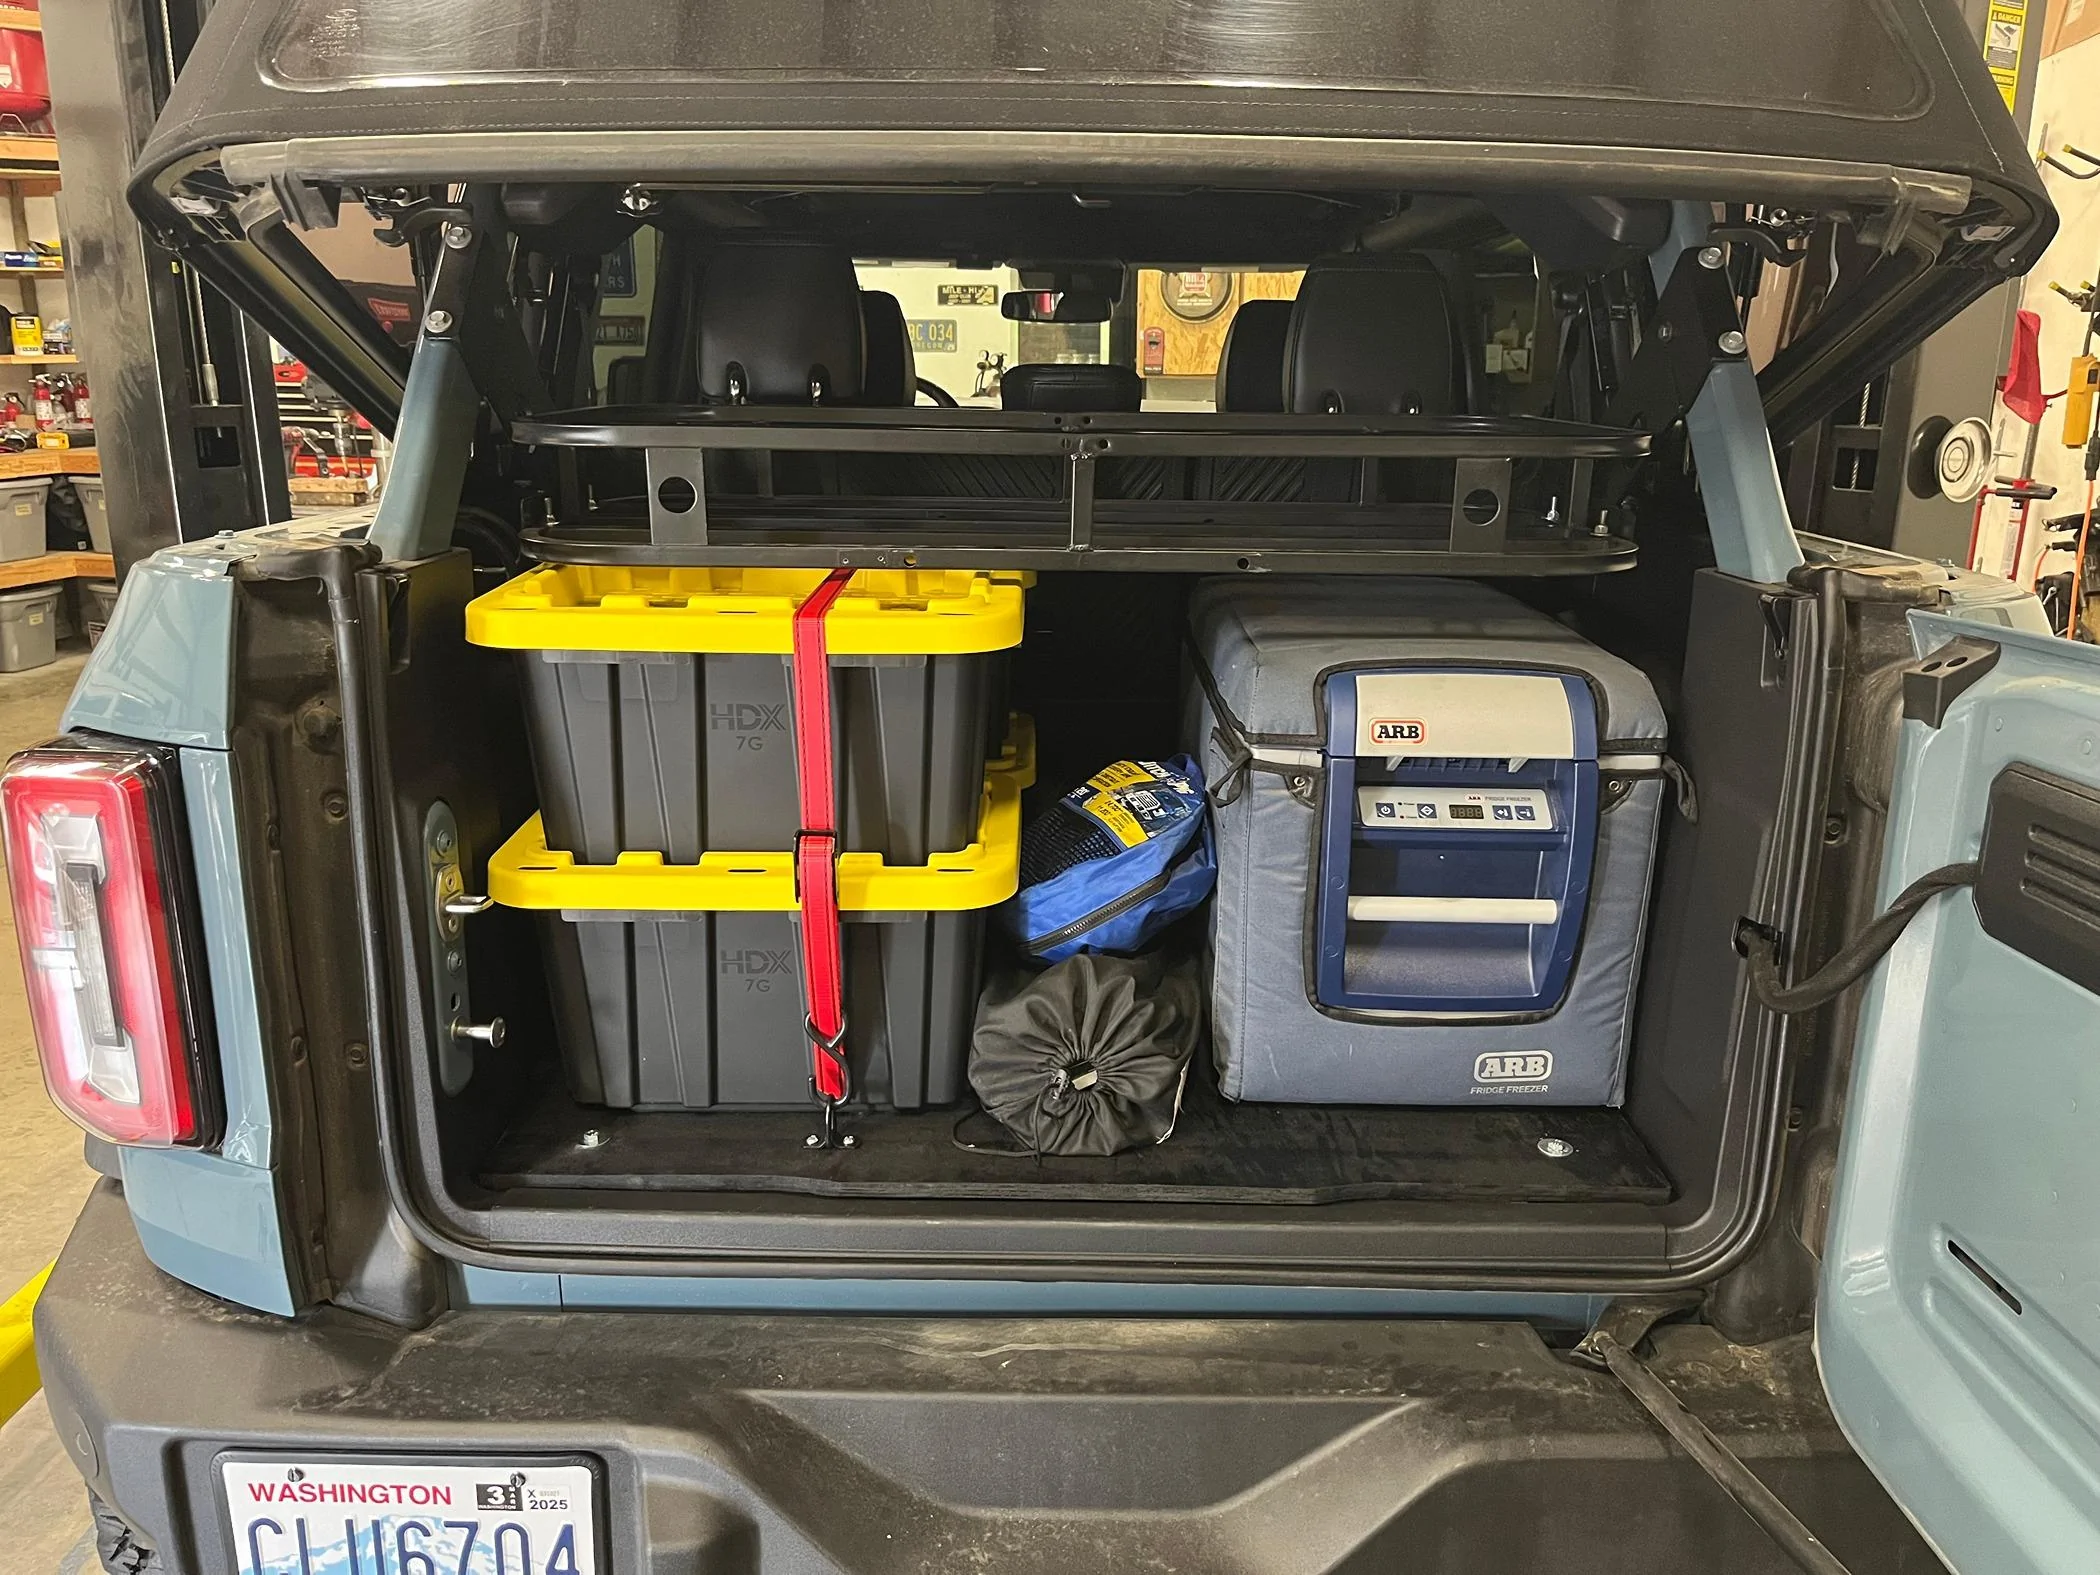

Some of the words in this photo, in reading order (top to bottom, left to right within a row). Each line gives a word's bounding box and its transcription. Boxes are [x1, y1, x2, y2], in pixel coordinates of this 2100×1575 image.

[929, 324, 953, 342] 034
[710, 703, 786, 731] HDX
[1377, 724, 1420, 739] ARB
[736, 735, 763, 751] 7G
[721, 949, 792, 975] HDX
[745, 978, 770, 993] 7G
[1481, 1056, 1545, 1078] ARB
[1470, 1086, 1505, 1095] FRIDGE
[1506, 1084, 1549, 1094] FREEZER
[248, 1482, 452, 1506] WASHINGTON
[486, 1485, 506, 1506] 3
[529, 1499, 569, 1510] 2025
